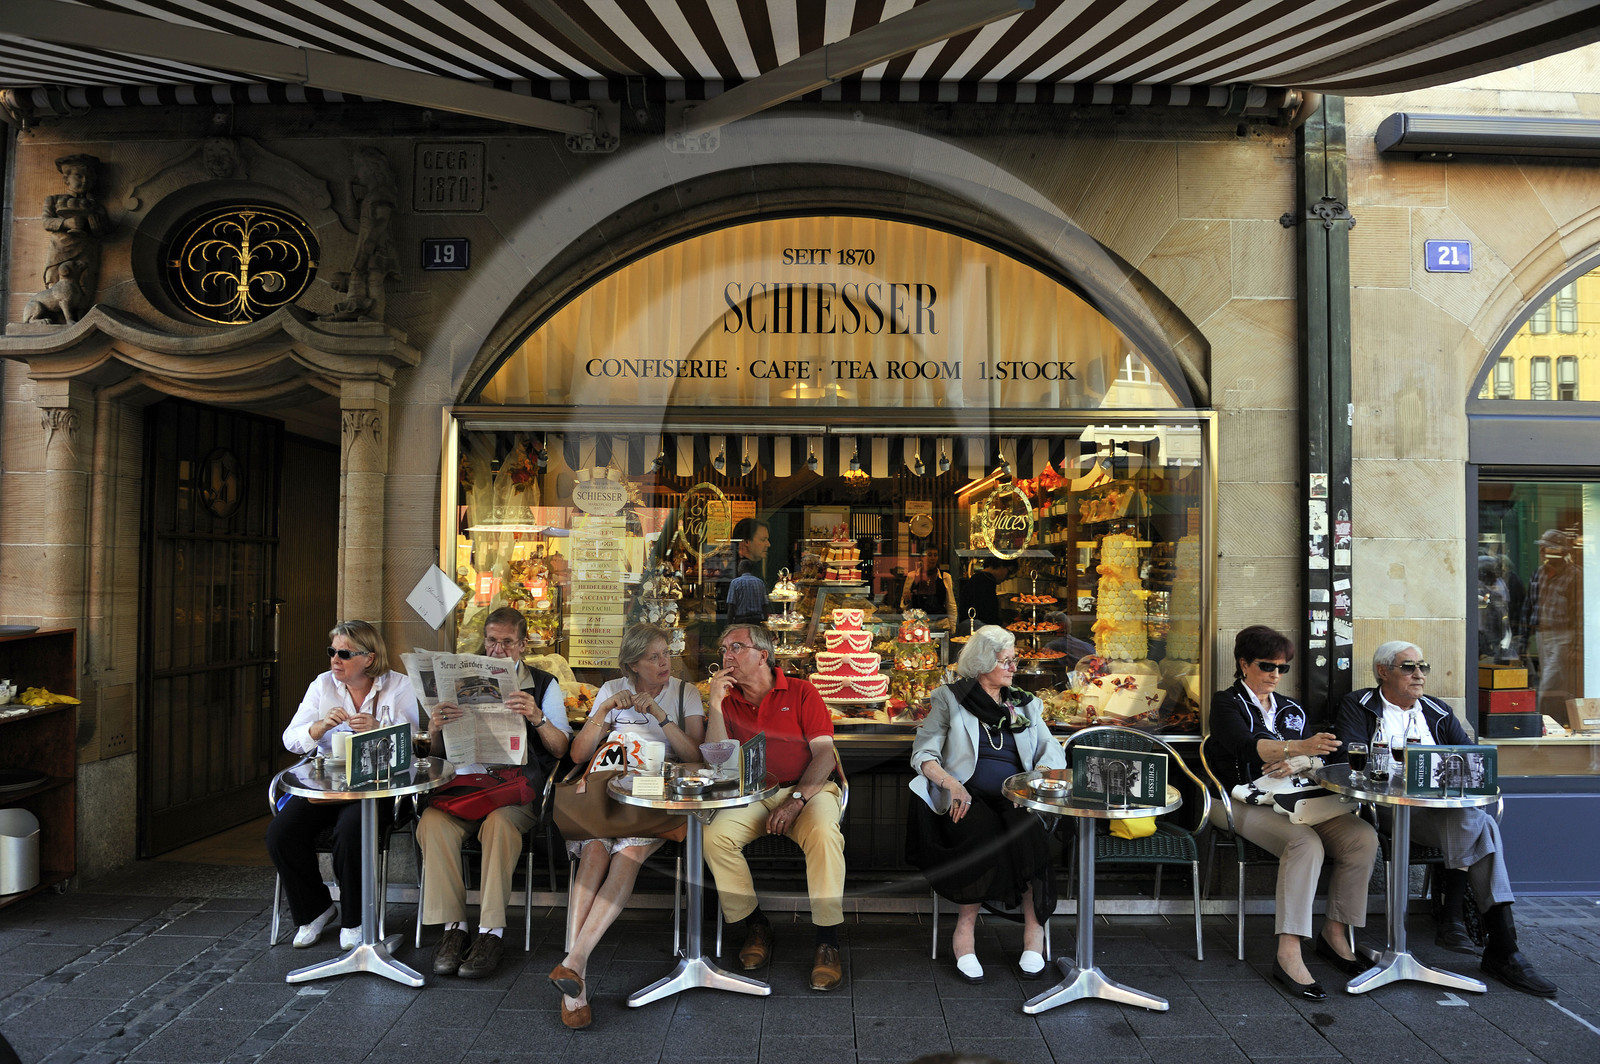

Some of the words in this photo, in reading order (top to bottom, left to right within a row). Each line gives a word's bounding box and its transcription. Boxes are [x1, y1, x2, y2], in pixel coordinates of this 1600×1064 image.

[433, 244, 455, 263] 19
[782, 248, 831, 265] SEIT
[837, 248, 876, 266] 1870
[1438, 246, 1460, 265] 21
[723, 281, 940, 335] SCHIESSER
[585, 358, 728, 379] CONFISERIE
[749, 360, 811, 379] CAFE
[831, 360, 879, 380] TEA
[886, 360, 962, 380] ROOM
[576, 491, 623, 502] SCHIESSER
[987, 508, 1029, 531] Glaces
